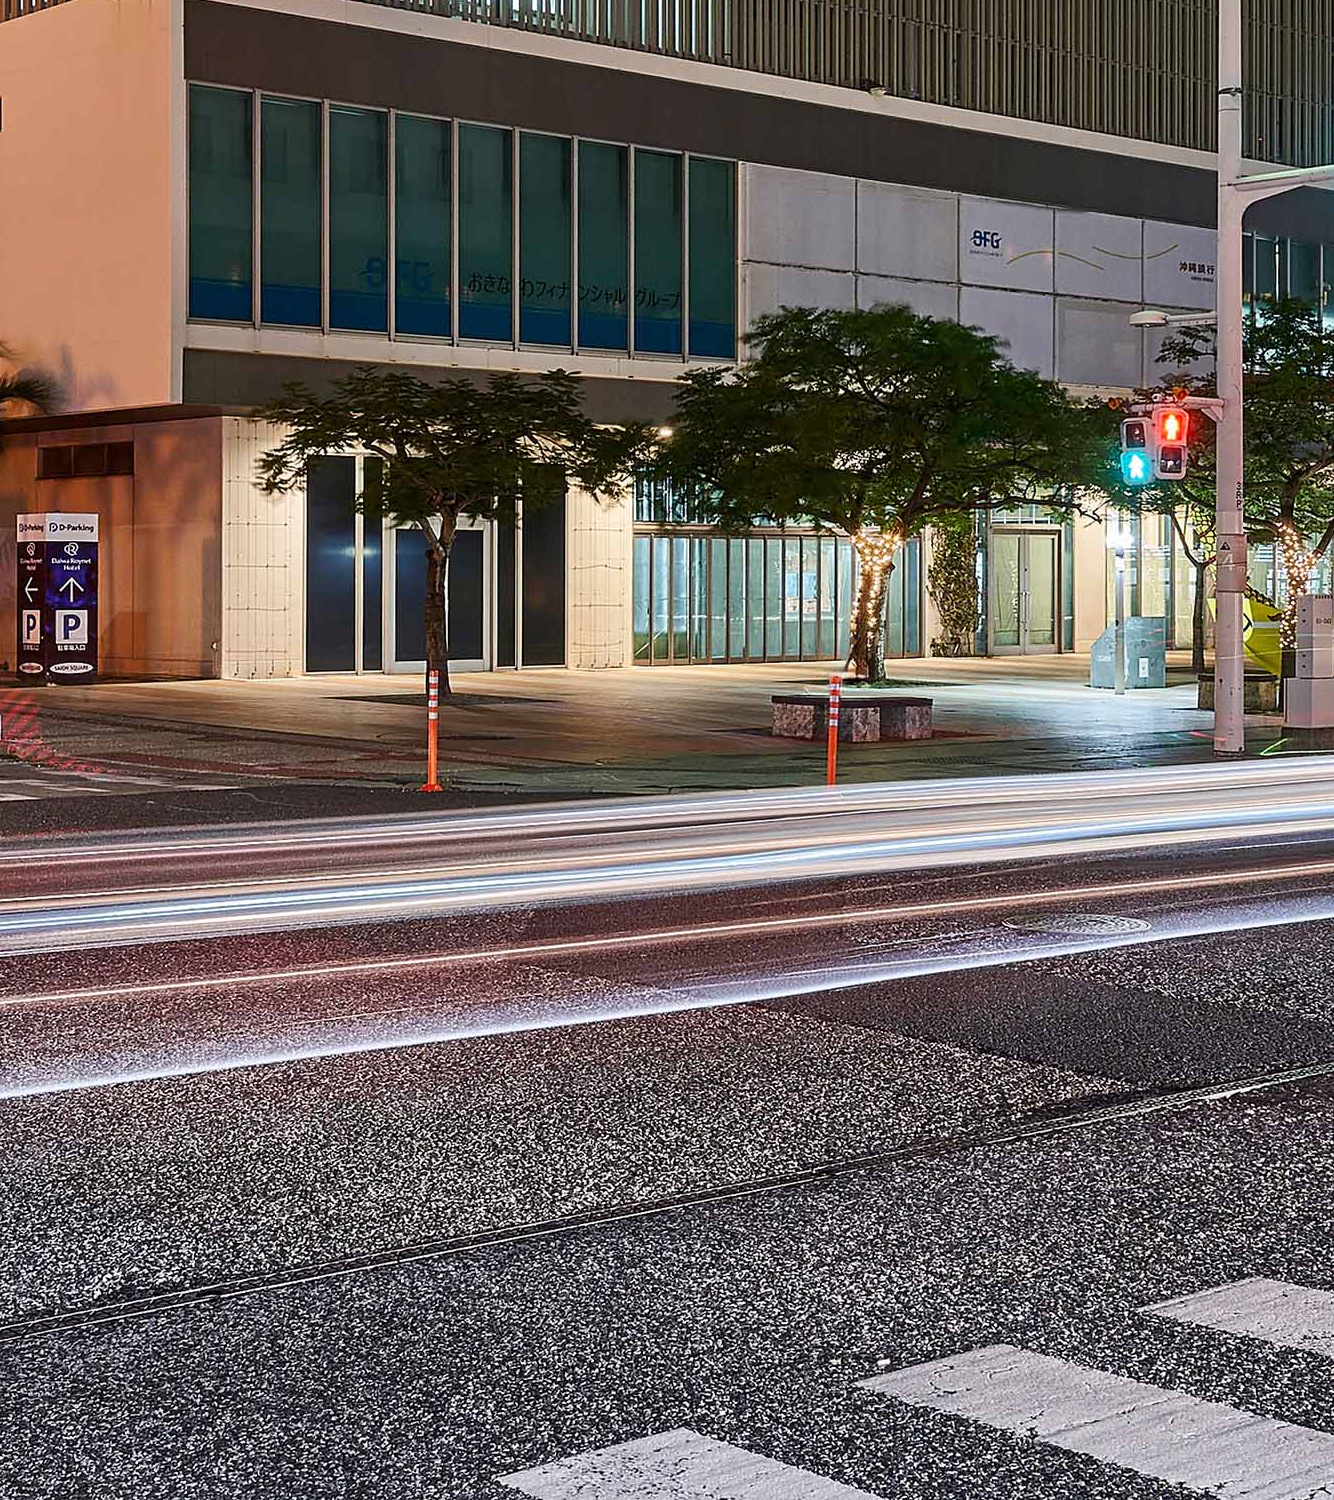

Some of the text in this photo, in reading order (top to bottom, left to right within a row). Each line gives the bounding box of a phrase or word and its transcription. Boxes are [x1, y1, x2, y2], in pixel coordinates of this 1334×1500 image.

[59, 524, 94, 533] D-Parking
[70, 557, 91, 566] Roynet
[63, 614, 81, 640] P
